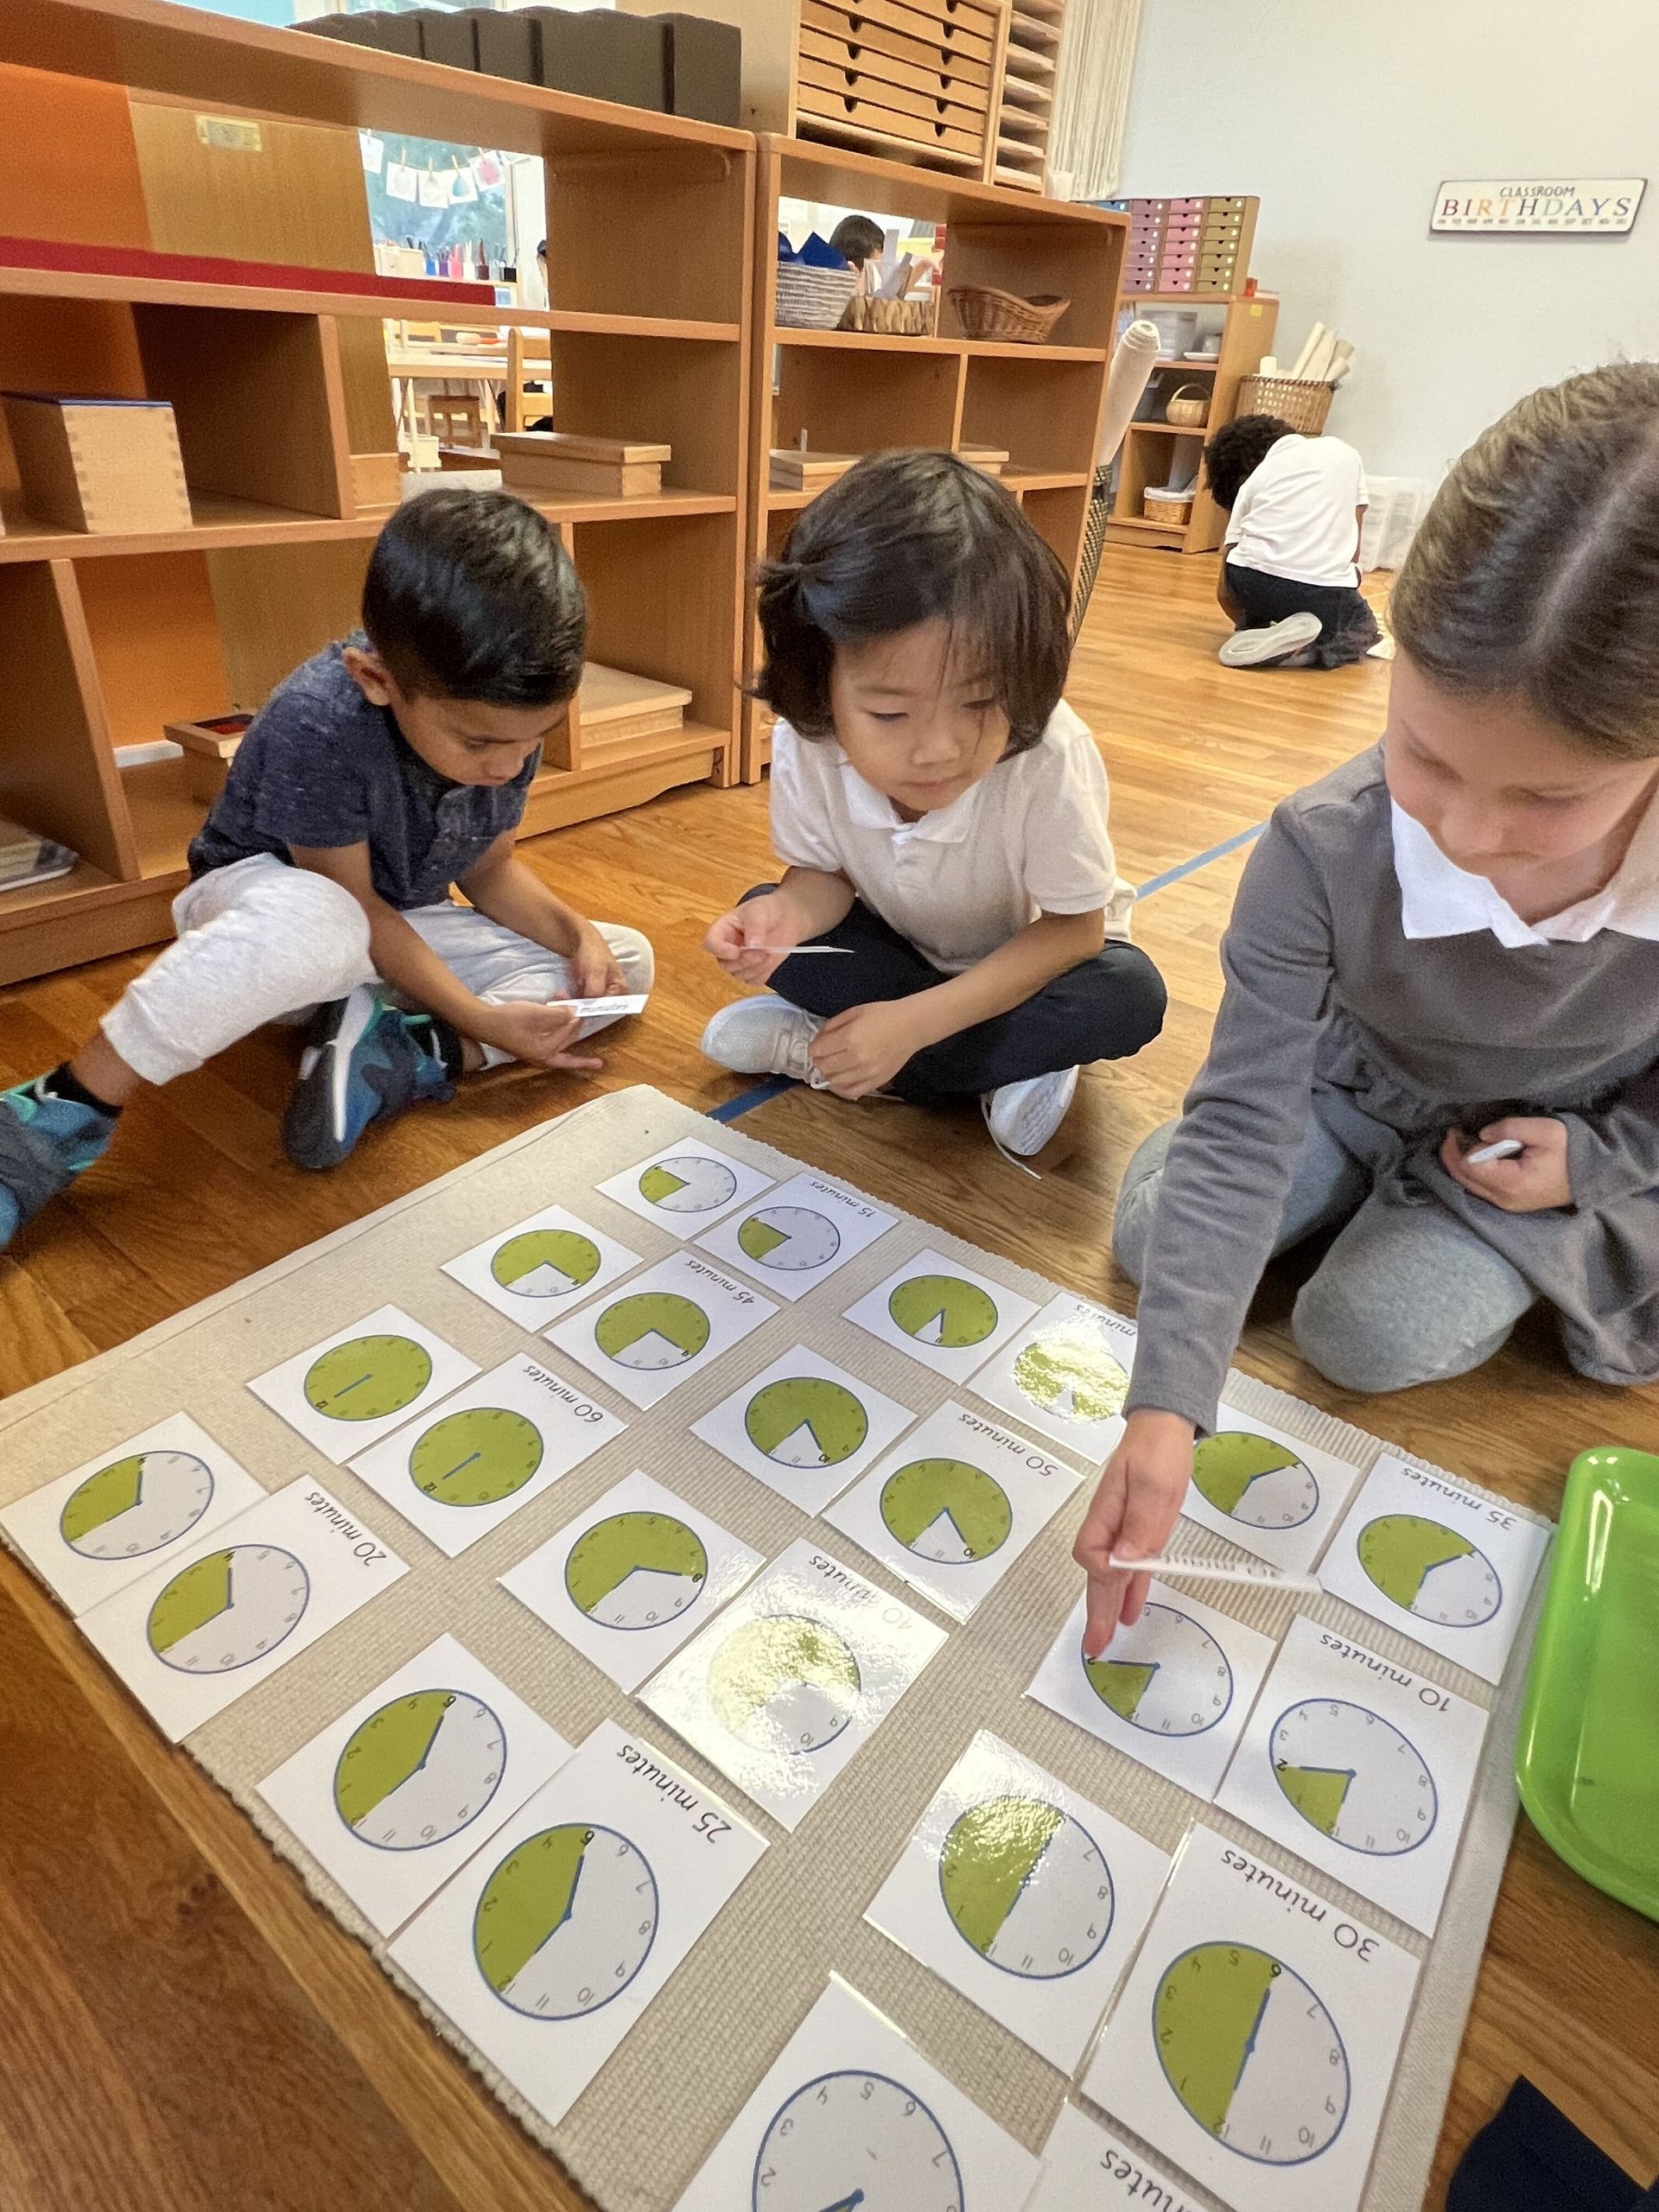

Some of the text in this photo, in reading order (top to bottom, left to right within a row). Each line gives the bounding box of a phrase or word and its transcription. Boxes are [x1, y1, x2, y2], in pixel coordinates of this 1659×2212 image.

[1500, 187, 1575, 197] CLASSROOM
[1442, 199, 1631, 216] BIRTHDAYS
[810, 1181, 876, 1217] 15 minutes
[684, 1261, 755, 1304] 45 minutes
[523, 1365, 602, 1422] 60 minutes
[958, 1414, 1058, 1476] 50 minutes
[423, 1482, 437, 1493] 12
[1402, 1468, 1517, 1530] 35 minutes
[304, 1492, 387, 1567] 20 minutes
[963, 1548, 976, 1559] 10
[692, 1573, 702, 1582] 8
[674, 1597, 683, 1607] 9
[614, 1614, 625, 1624] 11
[645, 1611, 658, 1622] 10
[1320, 1635, 1450, 1712] 10 minutes
[408, 1699, 418, 1709] 4
[443, 1695, 456, 1707] 5
[474, 1708, 486, 1719] 6
[1299, 1710, 1306, 1720] 4
[1330, 1706, 1338, 1716] 5
[371, 1718, 384, 1728] 3
[830, 1716, 837, 1726] 9
[1365, 1714, 1375, 1725] 6
[800, 1732, 815, 1745] 10
[1280, 1730, 1288, 1741] 3
[487, 1740, 501, 1750] 7
[1397, 1745, 1407, 1754] 7
[347, 1747, 361, 1758] 2
[1277, 1758, 1287, 1771] 2
[485, 1773, 496, 1783] 8
[1419, 1775, 1428, 1787] 8
[340, 1783, 353, 1793] 1
[617, 1745, 731, 1843] 25 minutes
[1298, 1795, 1302, 1804] 1
[457, 1805, 468, 1818] 9
[1417, 1808, 1426, 1821] 9
[351, 1812, 367, 1828] 12
[382, 1828, 397, 1841] 11
[421, 1826, 436, 1840] 10
[1326, 1821, 1340, 1837] 12
[1396, 1828, 1410, 1843] 10
[543, 1837, 554, 1849] 4
[581, 1830, 594, 1845] 5
[1366, 1835, 1375, 1847] 11
[617, 1844, 629, 1857] 6
[1083, 1848, 1095, 1861] 7
[506, 1860, 519, 1876] 3
[945, 1864, 957, 1877] 2
[636, 1881, 652, 1893] 7
[1097, 1886, 1108, 1900] 8
[484, 1897, 498, 1911] 2
[957, 1905, 963, 1917] 1
[1221, 1850, 1379, 1962] 30 minutes
[639, 1921, 651, 1935] 8
[1087, 1923, 1096, 1939] 9
[482, 1941, 493, 1953] 1
[981, 1937, 997, 1956] 12
[1021, 1955, 1033, 1970] 11
[1058, 1948, 1074, 1966] 10
[1229, 1950, 1241, 1966] 5
[615, 1961, 626, 1977] 9
[1192, 1956, 1201, 1973] 4
[1271, 1964, 1281, 1978] 6
[498, 1975, 515, 1994] 12
[578, 1987, 594, 2005] 10
[1166, 1986, 1177, 1999] 3
[536, 1993, 550, 2010] 11
[1306, 2004, 1319, 2018] 7
[1160, 2027, 1173, 2044] 2
[1329, 2049, 1340, 2065] 8
[1180, 2077, 1186, 2091] 1
[817, 2086, 827, 2105] 4
[860, 2082, 874, 2101] 5
[903, 2101, 916, 2116] 6
[1325, 2095, 1336, 2113] 9
[780, 2118, 793, 2136] 3
[1213, 2115, 1230, 2138] 12
[1299, 2127, 1315, 2148] 10
[1261, 2136, 1271, 2154] 11
[932, 2150, 948, 2168] 7
[760, 2166, 776, 2187] 2
[1100, 2150, 1192, 2212] nutes
